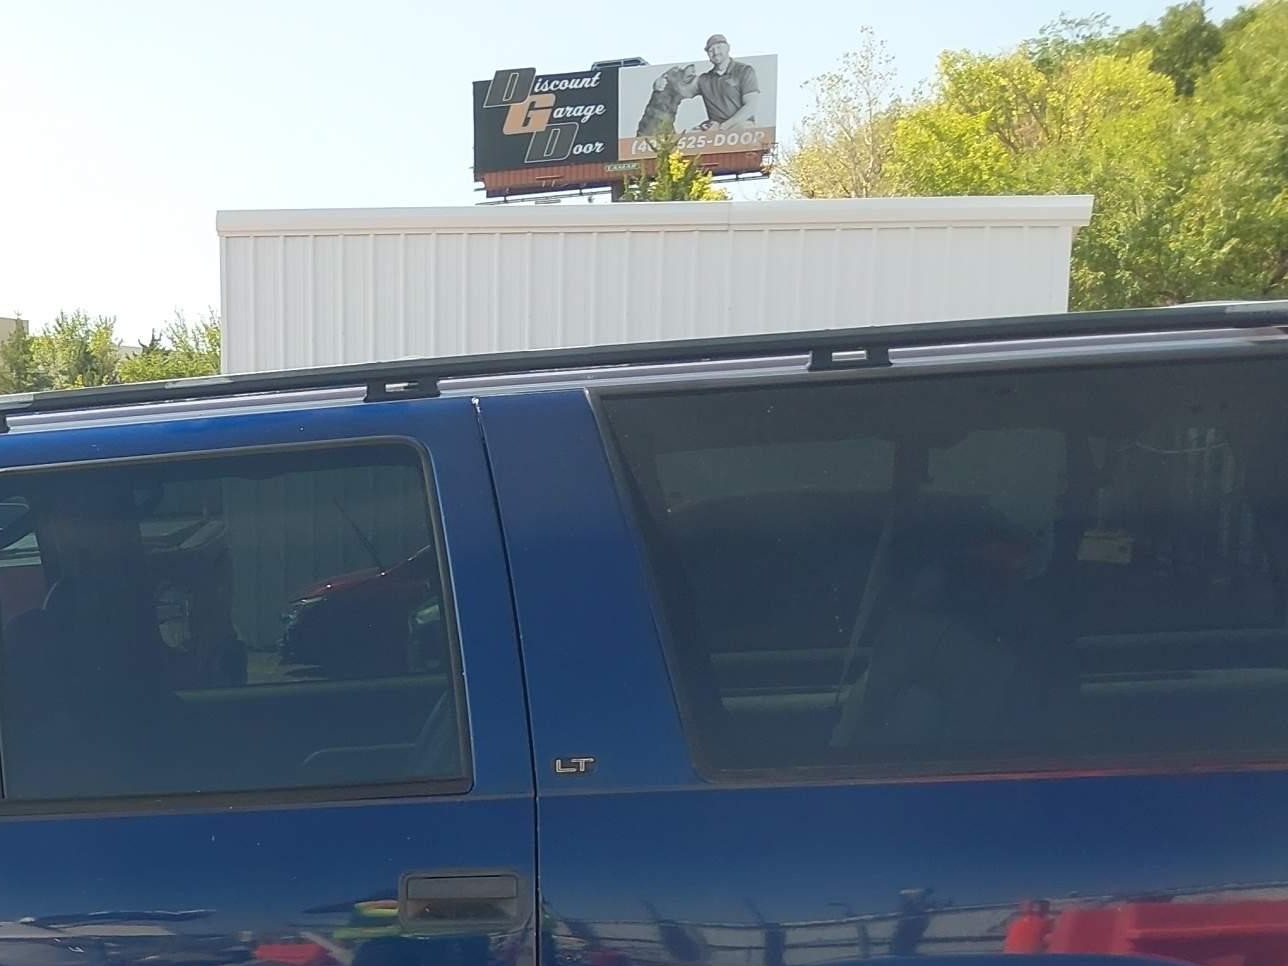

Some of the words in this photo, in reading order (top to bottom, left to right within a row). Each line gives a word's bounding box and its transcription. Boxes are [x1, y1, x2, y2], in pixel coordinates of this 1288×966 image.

[483, 67, 602, 108] Discount
[503, 93, 606, 135] Garage
[524, 122, 605, 163] Door
[555, 757, 594, 773] LT
